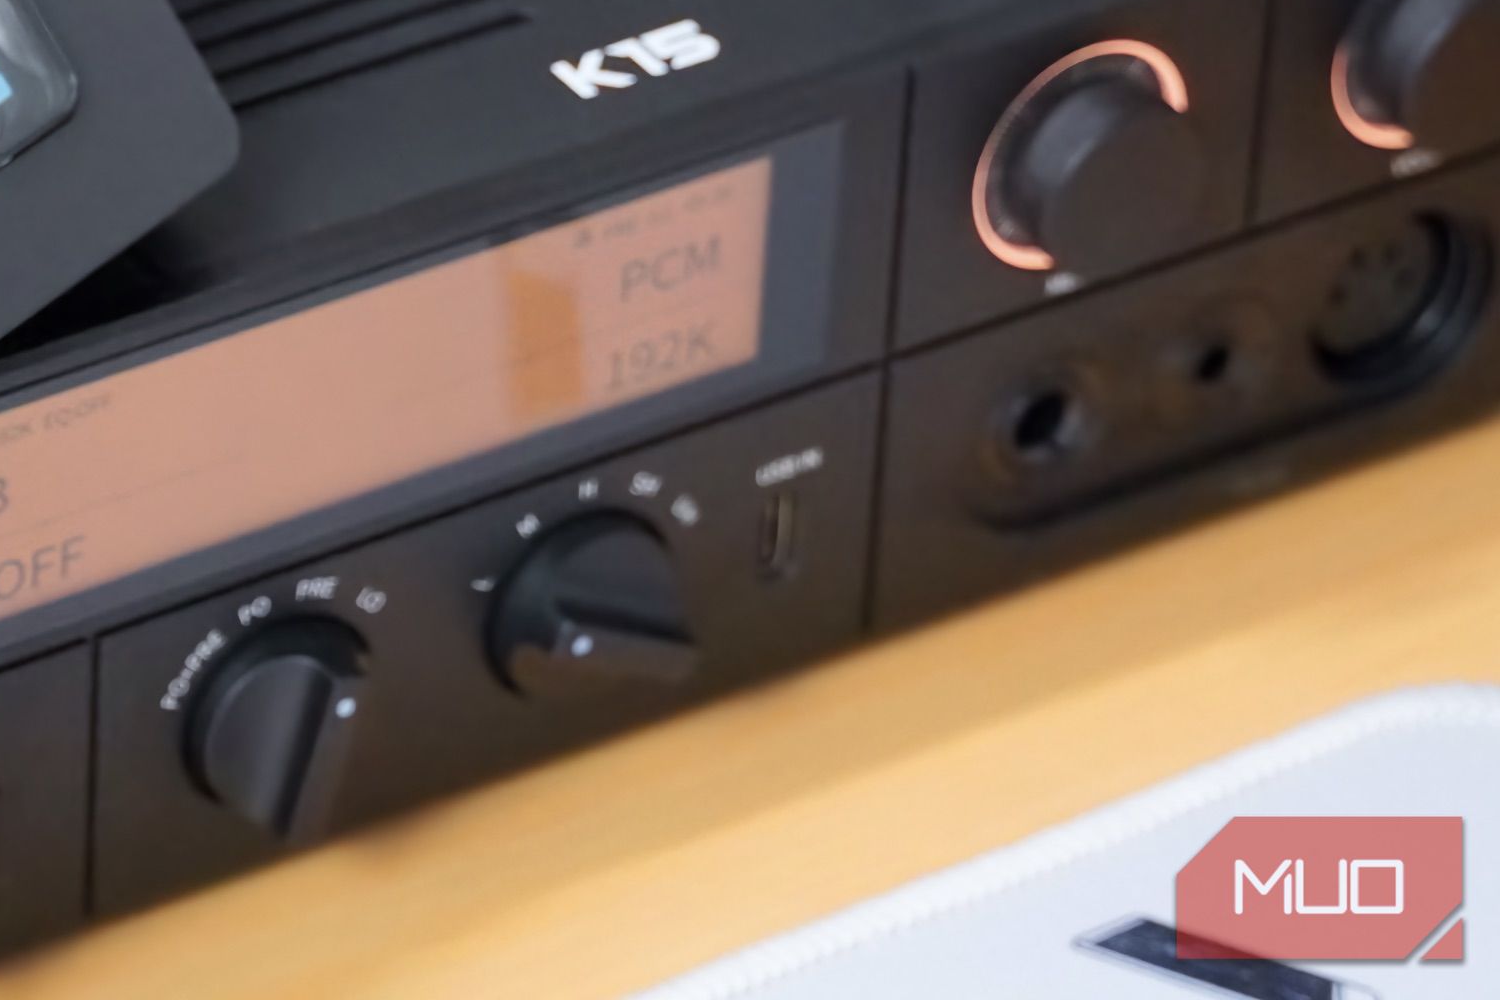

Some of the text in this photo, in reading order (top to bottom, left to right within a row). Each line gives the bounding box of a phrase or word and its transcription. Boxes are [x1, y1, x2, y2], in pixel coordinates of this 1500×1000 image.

[550, 18, 721, 100] K15
[620, 233, 721, 303] PCM
[605, 318, 717, 391] 192K
[237, 595, 272, 627] PO
[295, 576, 338, 601] PRE
